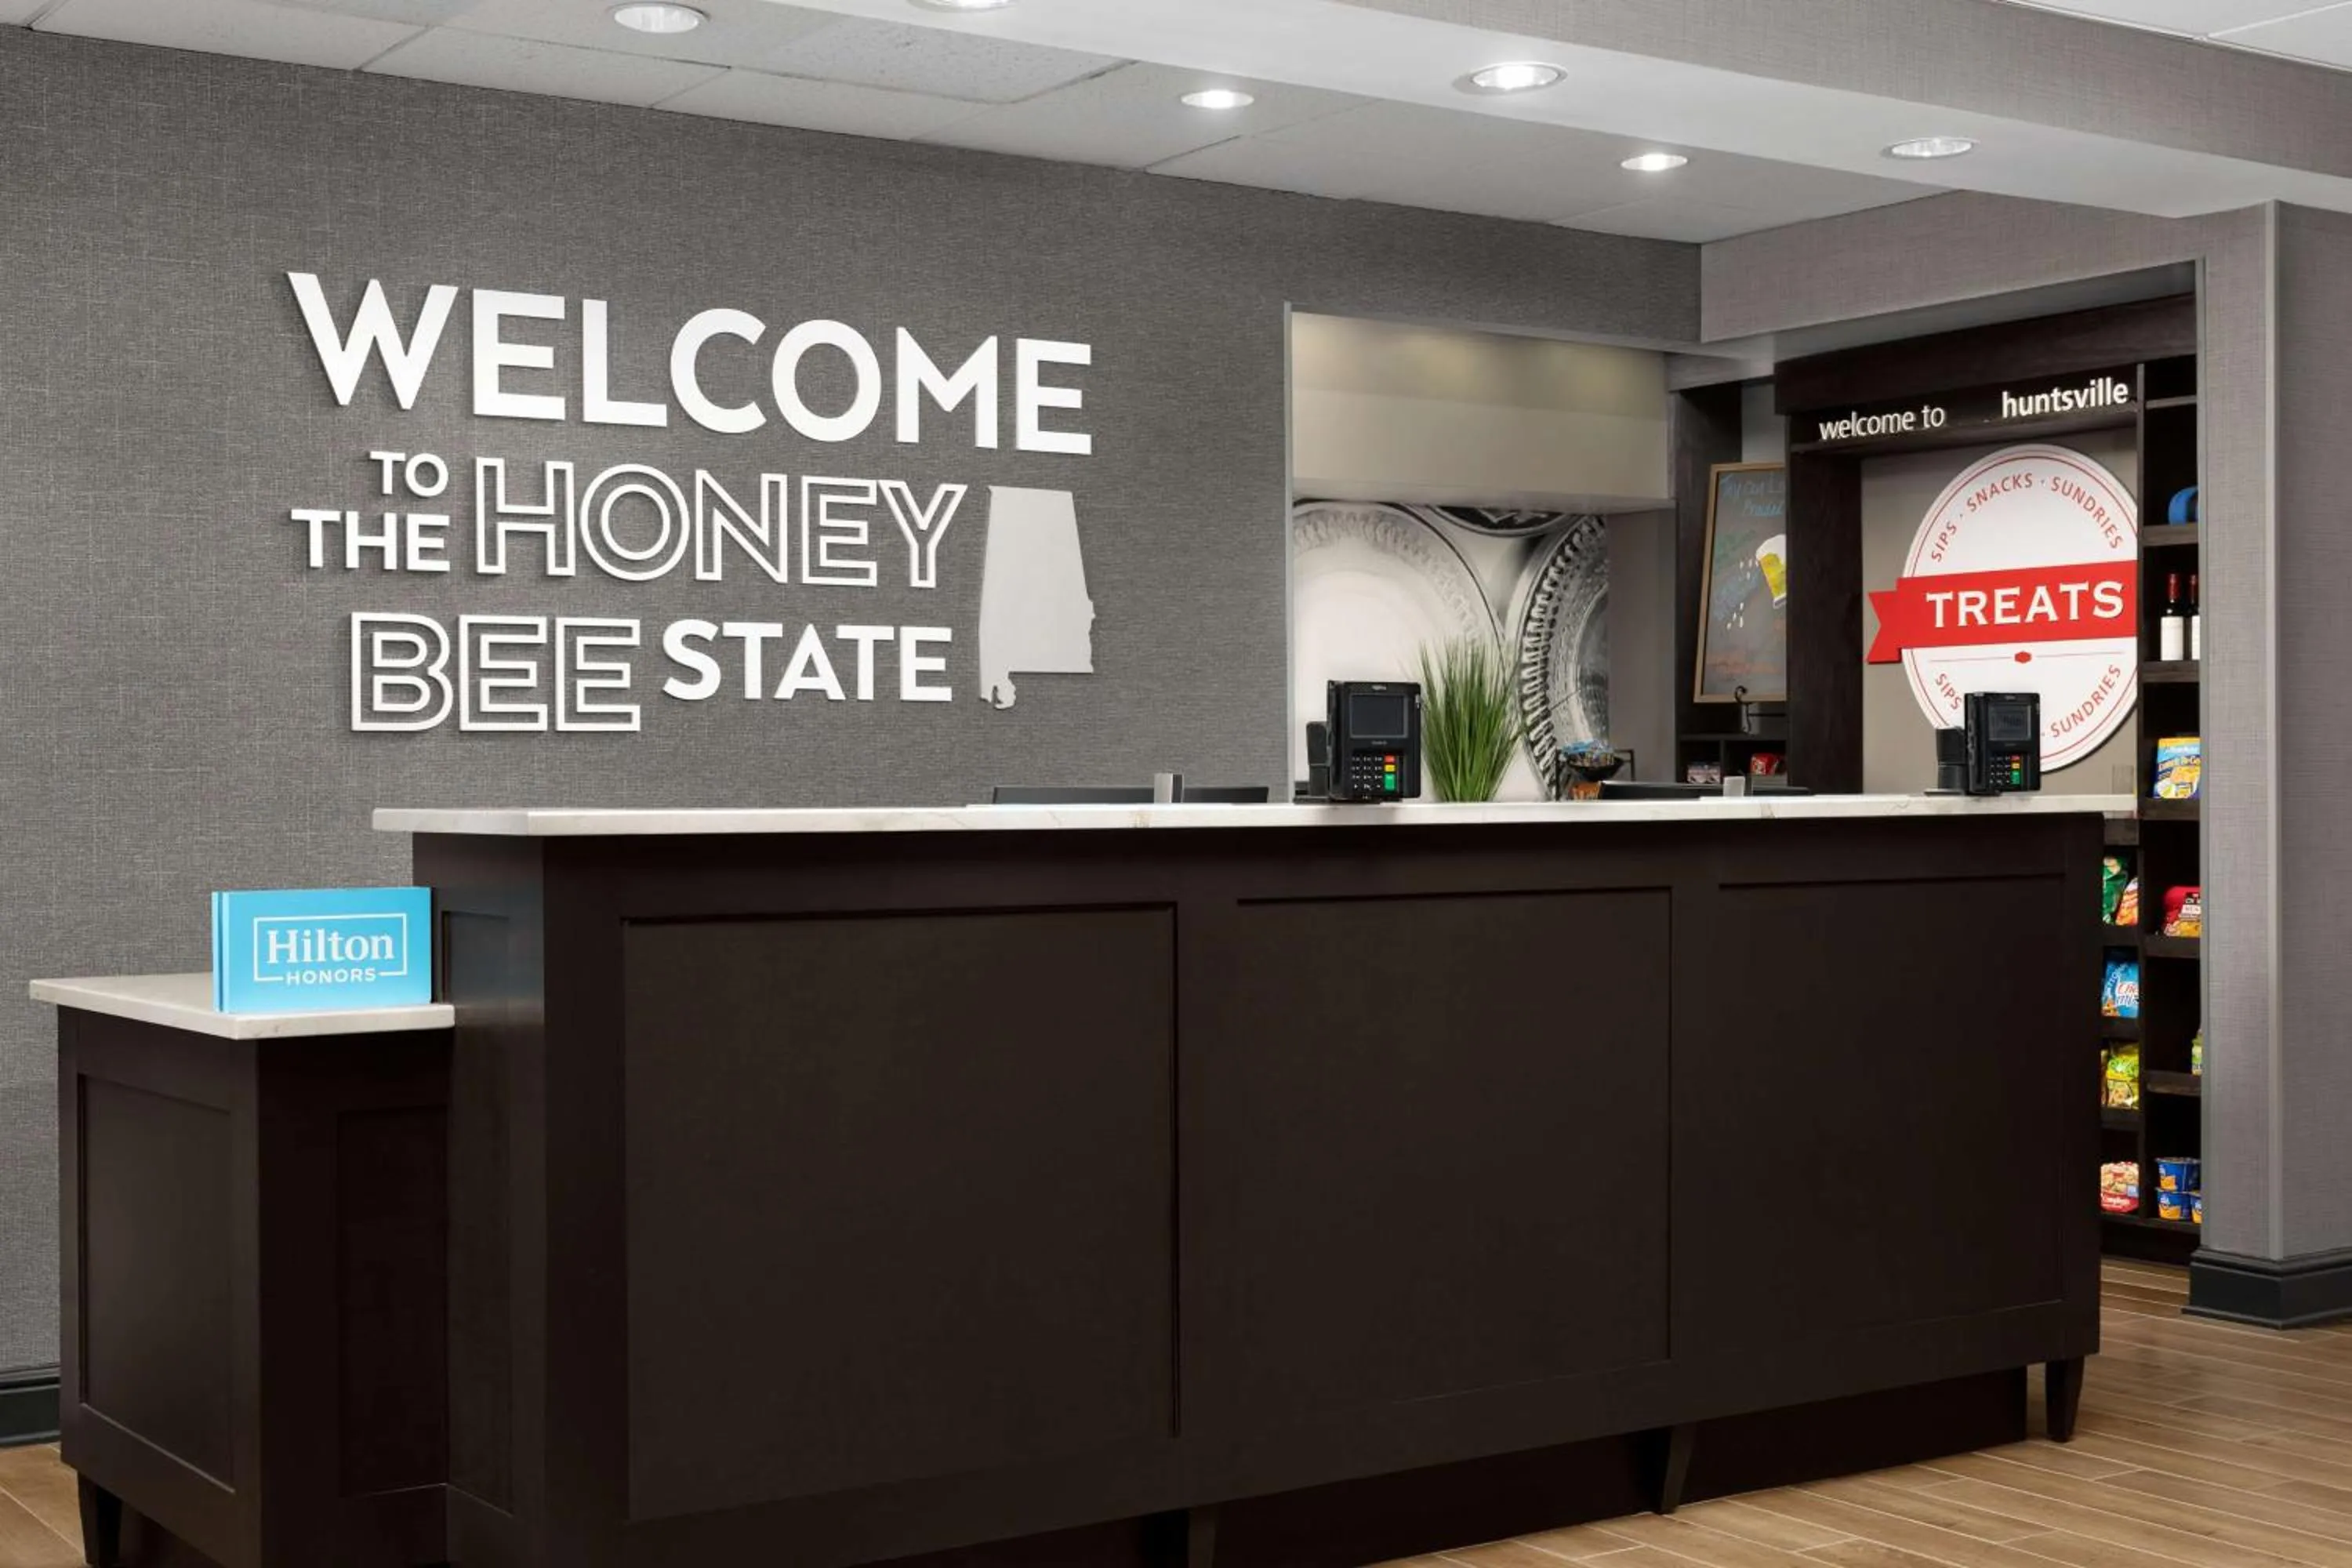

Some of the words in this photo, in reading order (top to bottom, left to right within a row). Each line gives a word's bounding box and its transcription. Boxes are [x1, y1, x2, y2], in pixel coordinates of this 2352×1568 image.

[287, 271, 1092, 456] WELCOME
[1819, 412, 1915, 441] welcome
[1922, 405, 1946, 429] to
[2002, 376, 2129, 419] huntsville
[369, 449, 450, 498] TO
[290, 507, 452, 572] THE
[475, 456, 969, 589] HONEY
[1930, 521, 1958, 563] SIPS
[1965, 472, 2034, 514] SNACKS
[2049, 475, 2124, 550] SUNDRIES
[1926, 580, 2125, 629] TREATS
[350, 611, 641, 732] BEE
[662, 618, 953, 702] STATE
[1933, 672, 1962, 711] SIPS
[2049, 663, 2122, 739] SUNDRIES
[267, 927, 395, 964] Hilton
[285, 967, 378, 986] HONORS
